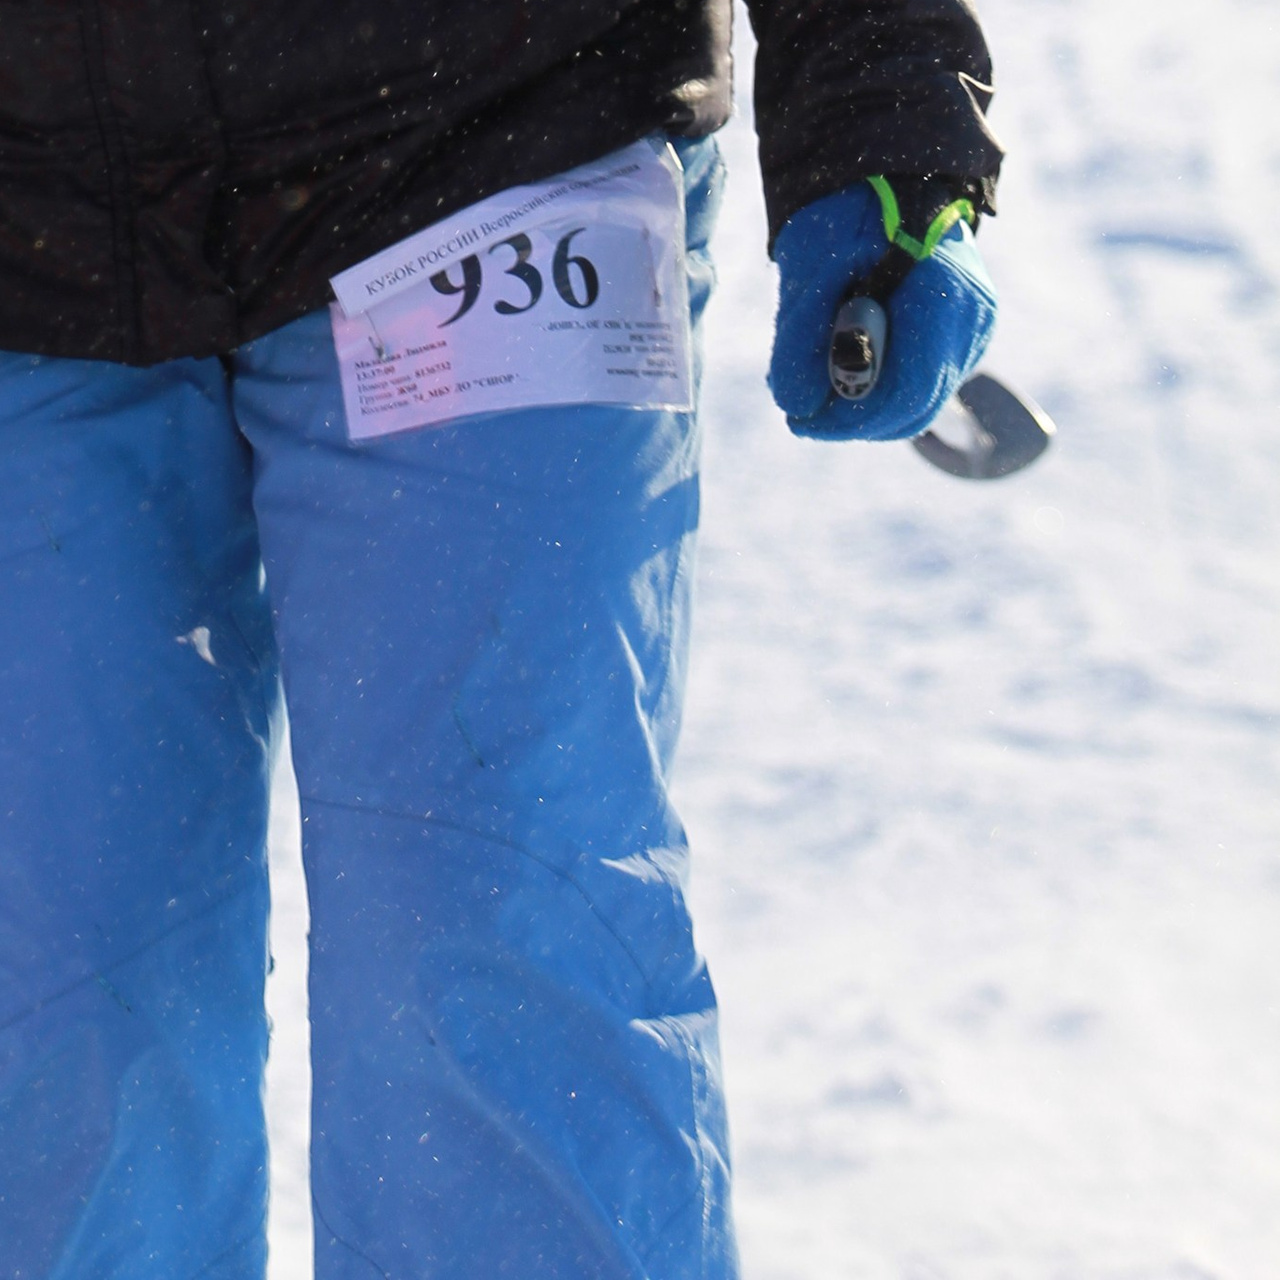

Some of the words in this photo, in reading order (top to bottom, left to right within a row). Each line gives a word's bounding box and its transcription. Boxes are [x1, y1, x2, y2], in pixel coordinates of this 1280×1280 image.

[365, 261, 418, 296] КУБОК
[420, 229, 478, 269] РОССИИ
[480, 185, 570, 236] Всероссийские
[429, 227, 600, 328] 936
